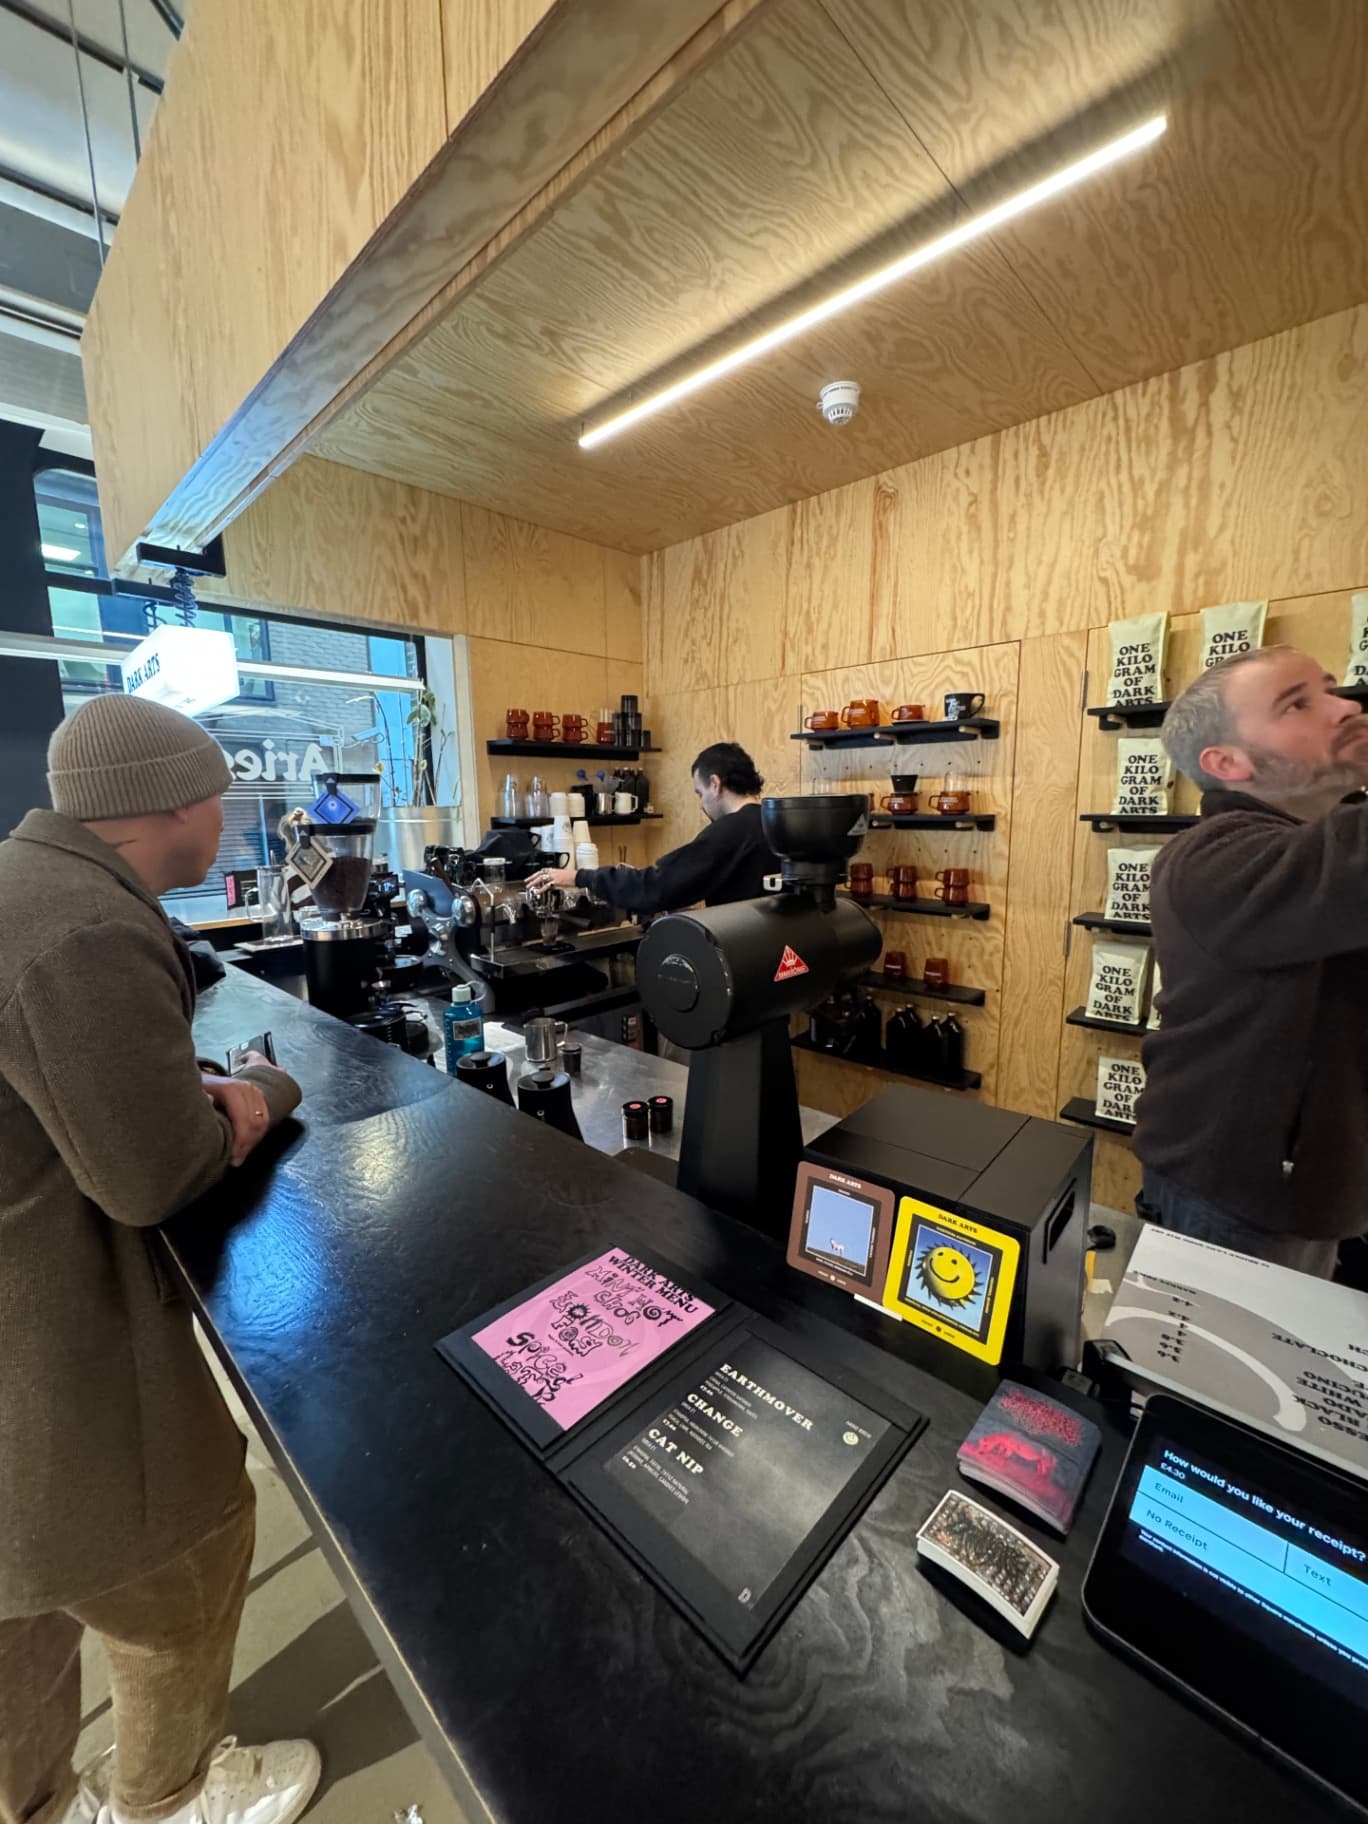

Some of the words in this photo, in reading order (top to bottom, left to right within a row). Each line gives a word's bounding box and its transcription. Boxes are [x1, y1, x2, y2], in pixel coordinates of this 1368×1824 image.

[1211, 629, 1248, 644] ONE
[1119, 643, 1151, 655] ONE
[1209, 641, 1250, 656] KILO
[1116, 653, 1153, 667] KILO
[126, 668, 143, 694] DARK
[144, 652, 161, 680] ARTS
[1114, 664, 1156, 678] GRAM
[1124, 676, 1143, 687] OF
[1112, 685, 1155, 698] DARK
[1128, 754, 1158, 764] ONE
[1124, 765, 1159, 775] KILO
[1120, 775, 1162, 785] GRAM
[1129, 786, 1149, 796] OF
[1118, 795, 1159, 806] DARK
[1119, 806, 1158, 814] ARTS
[1118, 862, 1149, 872] ONE
[1115, 872, 1150, 882] KILO
[1122, 893, 1141, 902] OF
[1111, 901, 1151, 913] DARK
[1112, 911, 1151, 920] ARTS
[1102, 965, 1131, 977] ONE
[1099, 974, 1133, 987] KILO
[1095, 982, 1135, 996] GRAM
[1104, 994, 1123, 1004] OF
[1093, 999, 1132, 1015] DARK
[1095, 1010, 1130, 1021] ARTS
[1111, 1063, 1141, 1076] ONE
[1108, 1071, 1142, 1085] KILO
[1103, 1081, 1144, 1094] GRAM
[1114, 1092, 1133, 1103] OF
[1103, 1099, 1132, 1113] DAR
[828, 1173, 845, 1184] DARK
[846, 1178, 862, 1190] ARTS
[938, 1214, 957, 1226] DARK
[959, 1222, 978, 1234] ARTS
[608, 1255, 657, 1289] WINTER
[655, 1286, 699, 1314] MENU
[624, 1256, 657, 1280] DARK
[658, 1279, 695, 1303] ARTS
[1296, 1376, 1362, 1408] WHITE
[1303, 1370, 1368, 1401] UCINO
[719, 1363, 814, 1432] EARTHMOVER
[687, 1393, 744, 1438] CHANGE
[1292, 1394, 1360, 1428] BLACK
[648, 1428, 678, 1453] CAT
[675, 1450, 704, 1474] NIP
[1160, 1462, 1186, 1480] £4.30
[1154, 1482, 1184, 1504] Email
[1164, 1449, 1189, 1469] How
[1190, 1464, 1226, 1488] would
[1226, 1483, 1250, 1501] you
[1252, 1495, 1274, 1514] like
[1275, 1509, 1306, 1530] your
[1308, 1526, 1367, 1562] receipt?
[1146, 1509, 1162, 1524] No
[1164, 1519, 1208, 1551] Receipt
[1303, 1563, 1332, 1587] Text
